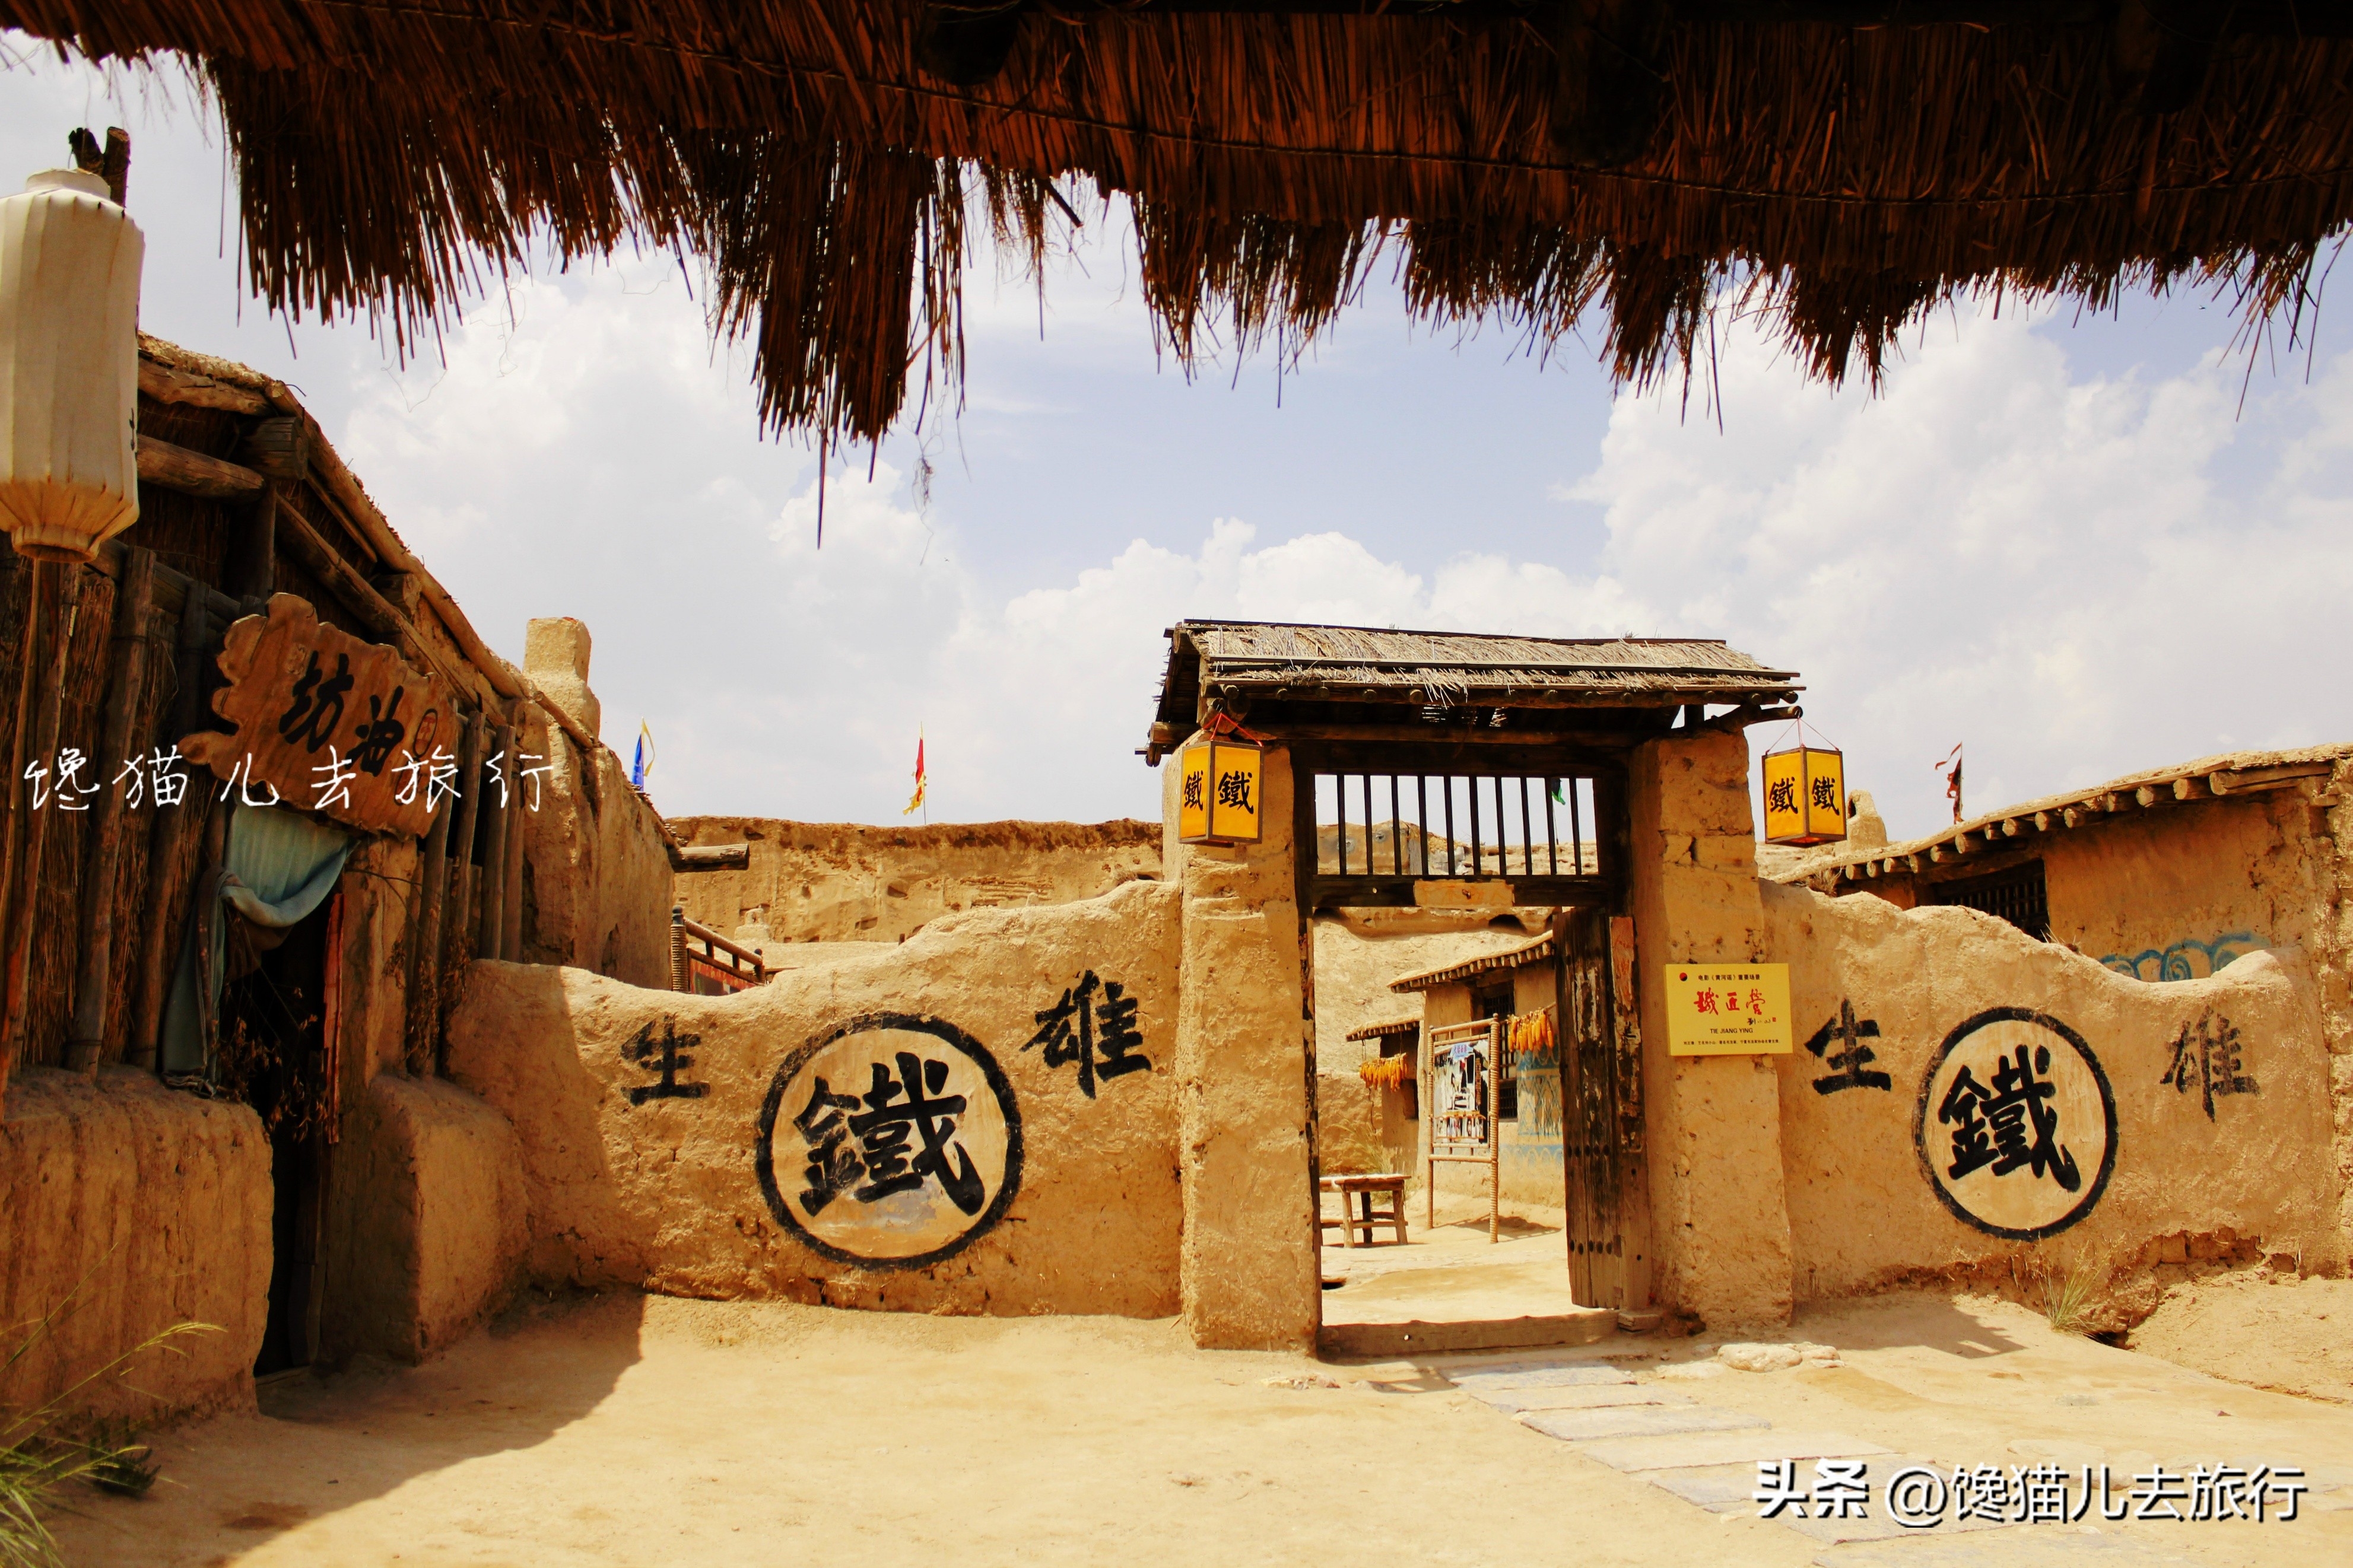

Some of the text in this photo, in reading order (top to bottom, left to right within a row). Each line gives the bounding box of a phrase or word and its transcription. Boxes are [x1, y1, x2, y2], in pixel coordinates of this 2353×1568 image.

[1218, 770, 1254, 815] 鐵
[1769, 777, 1798, 815] 鐵
[1938, 1044, 2082, 1192] 鐵
